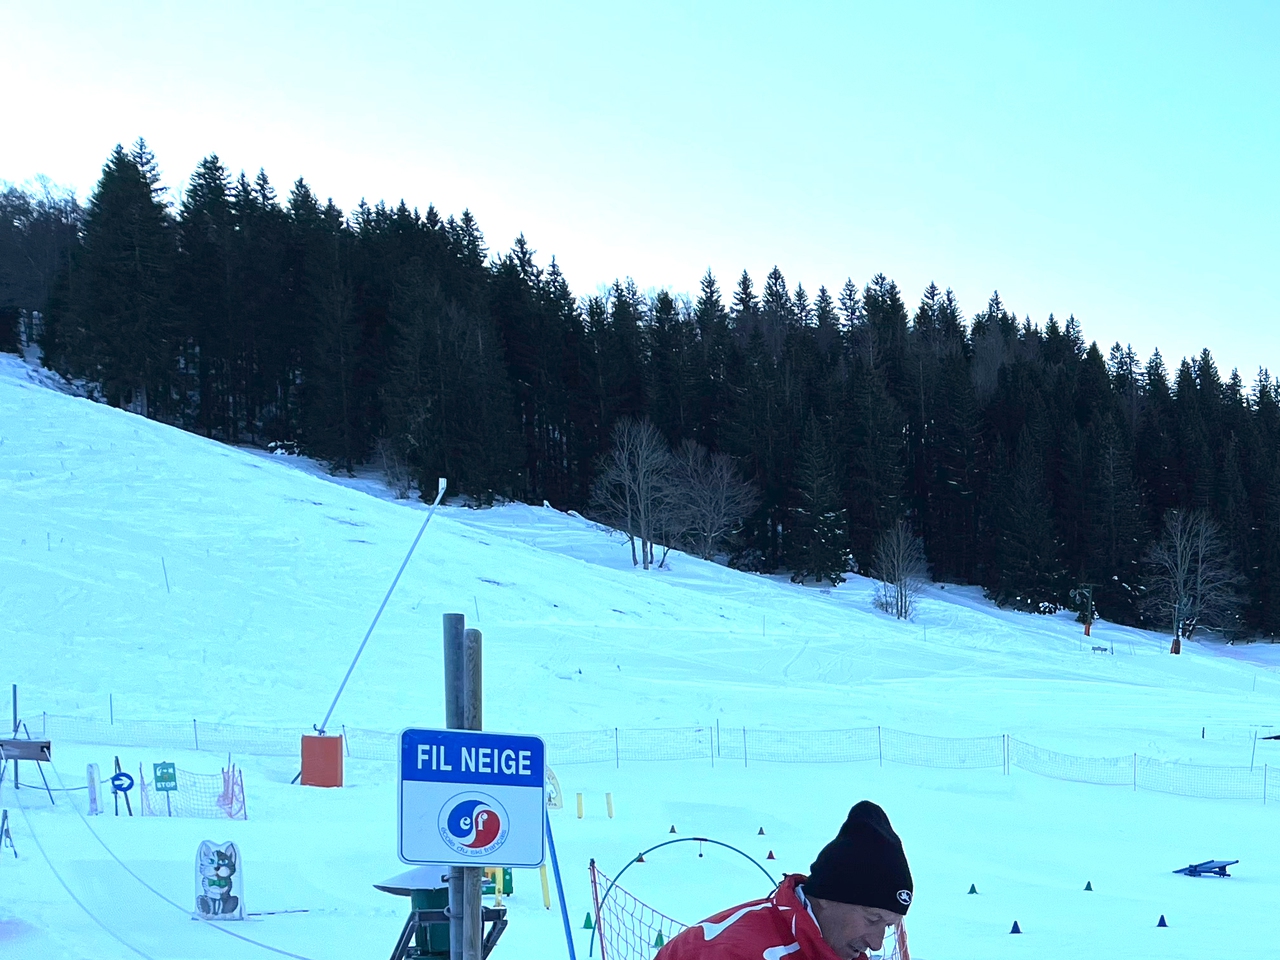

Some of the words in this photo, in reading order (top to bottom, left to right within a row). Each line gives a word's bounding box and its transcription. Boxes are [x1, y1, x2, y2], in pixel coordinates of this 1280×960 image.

[417, 744, 452, 771] FIL
[461, 747, 531, 775] NEIGE
[456, 846, 468, 854] du
